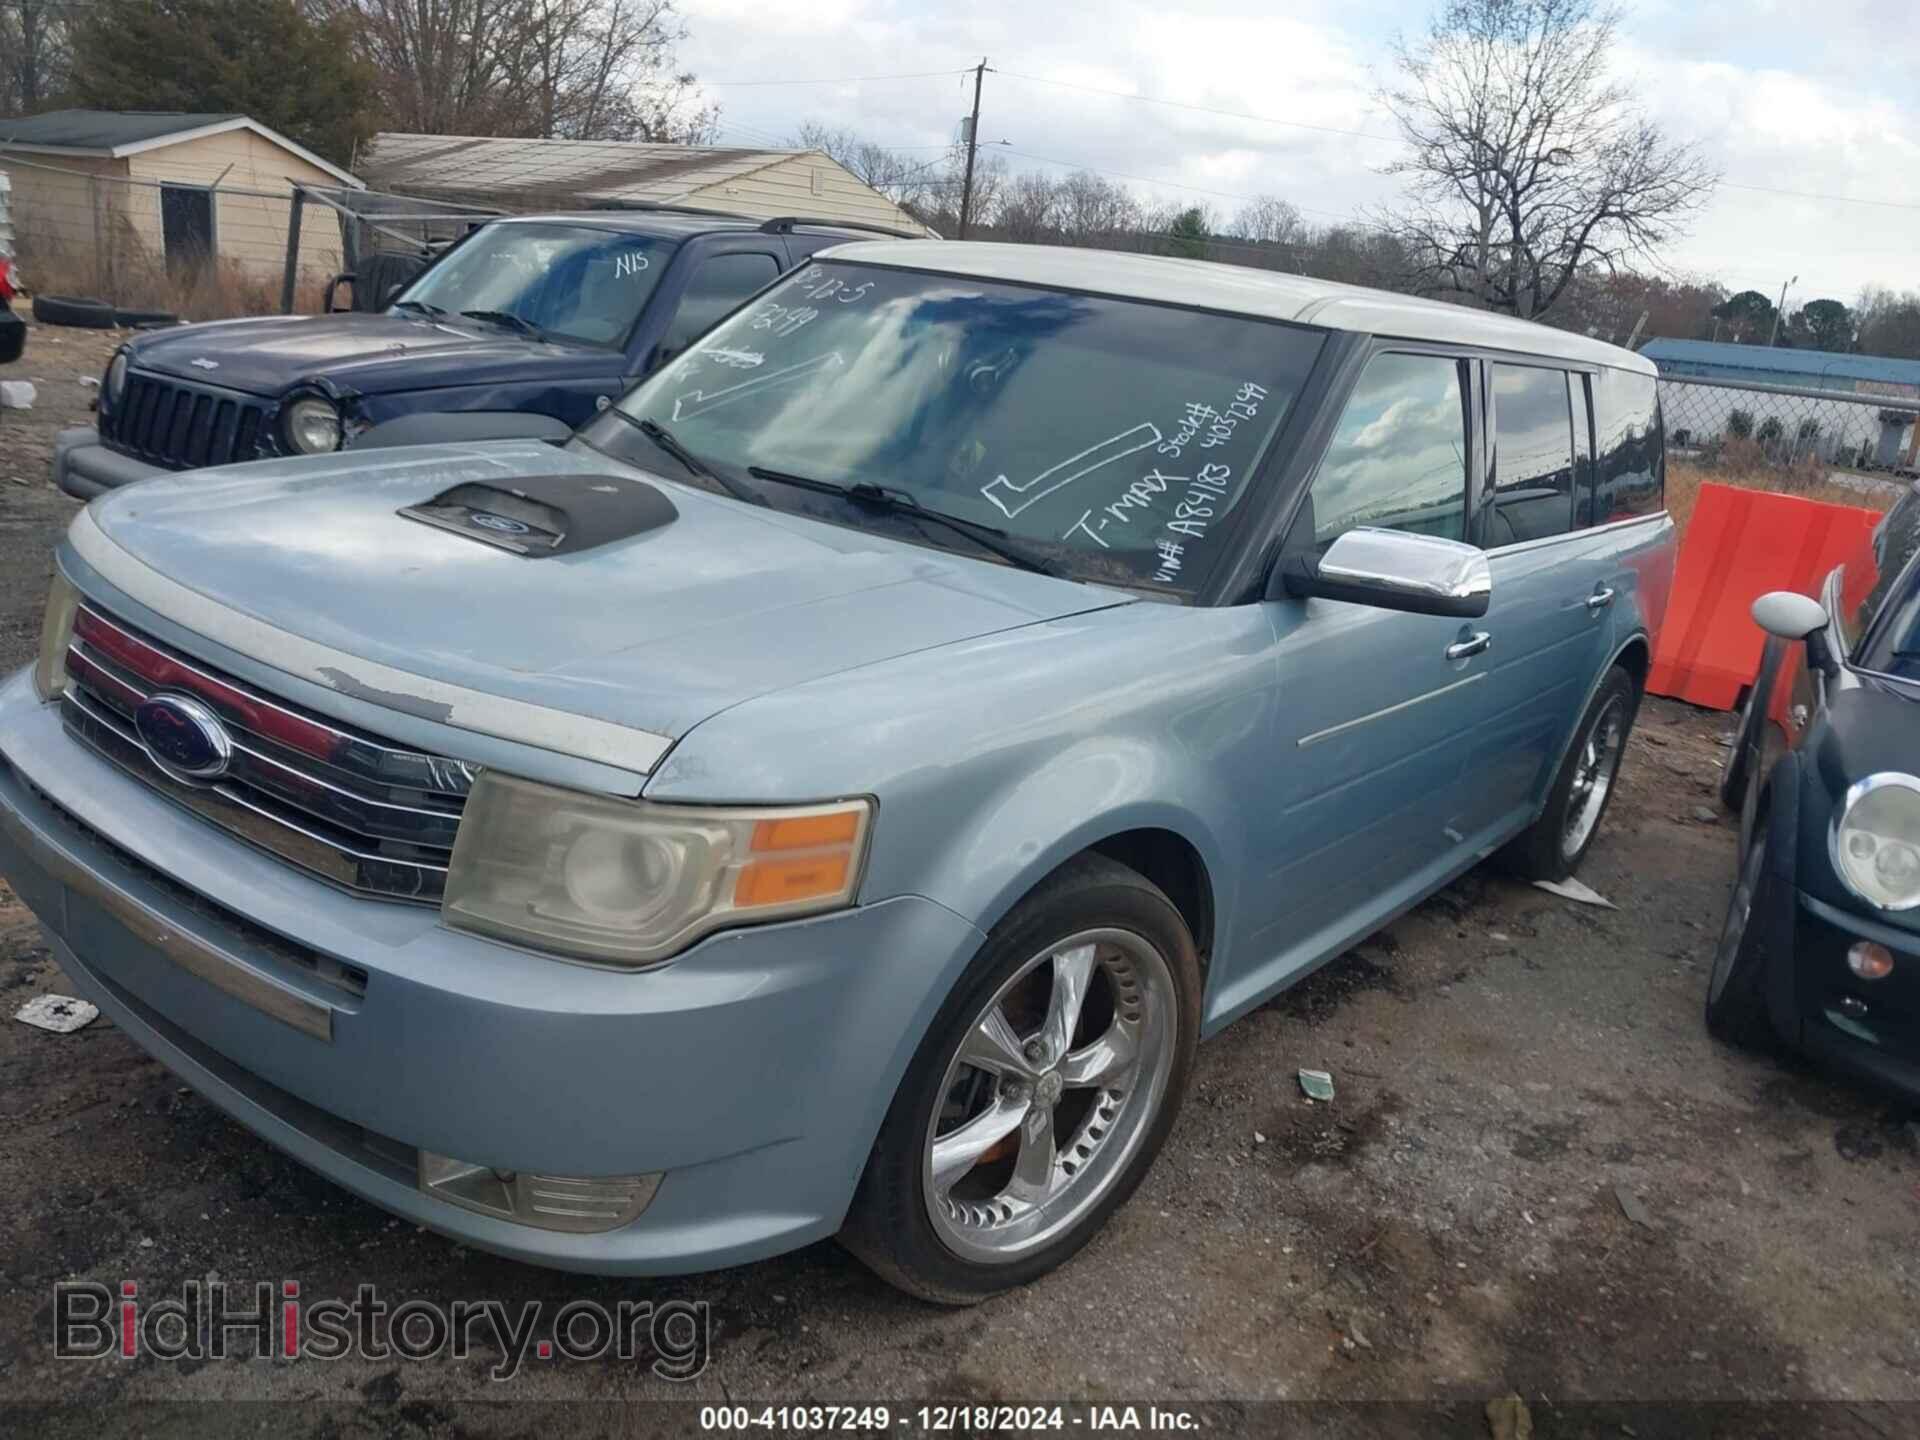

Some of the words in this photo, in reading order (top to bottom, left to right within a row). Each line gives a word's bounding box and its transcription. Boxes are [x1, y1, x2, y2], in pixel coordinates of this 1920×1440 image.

[1158, 402, 1218, 458] Stock#
[1200, 383, 1268, 448] 41037249
[1167, 463, 1231, 538] A84183
